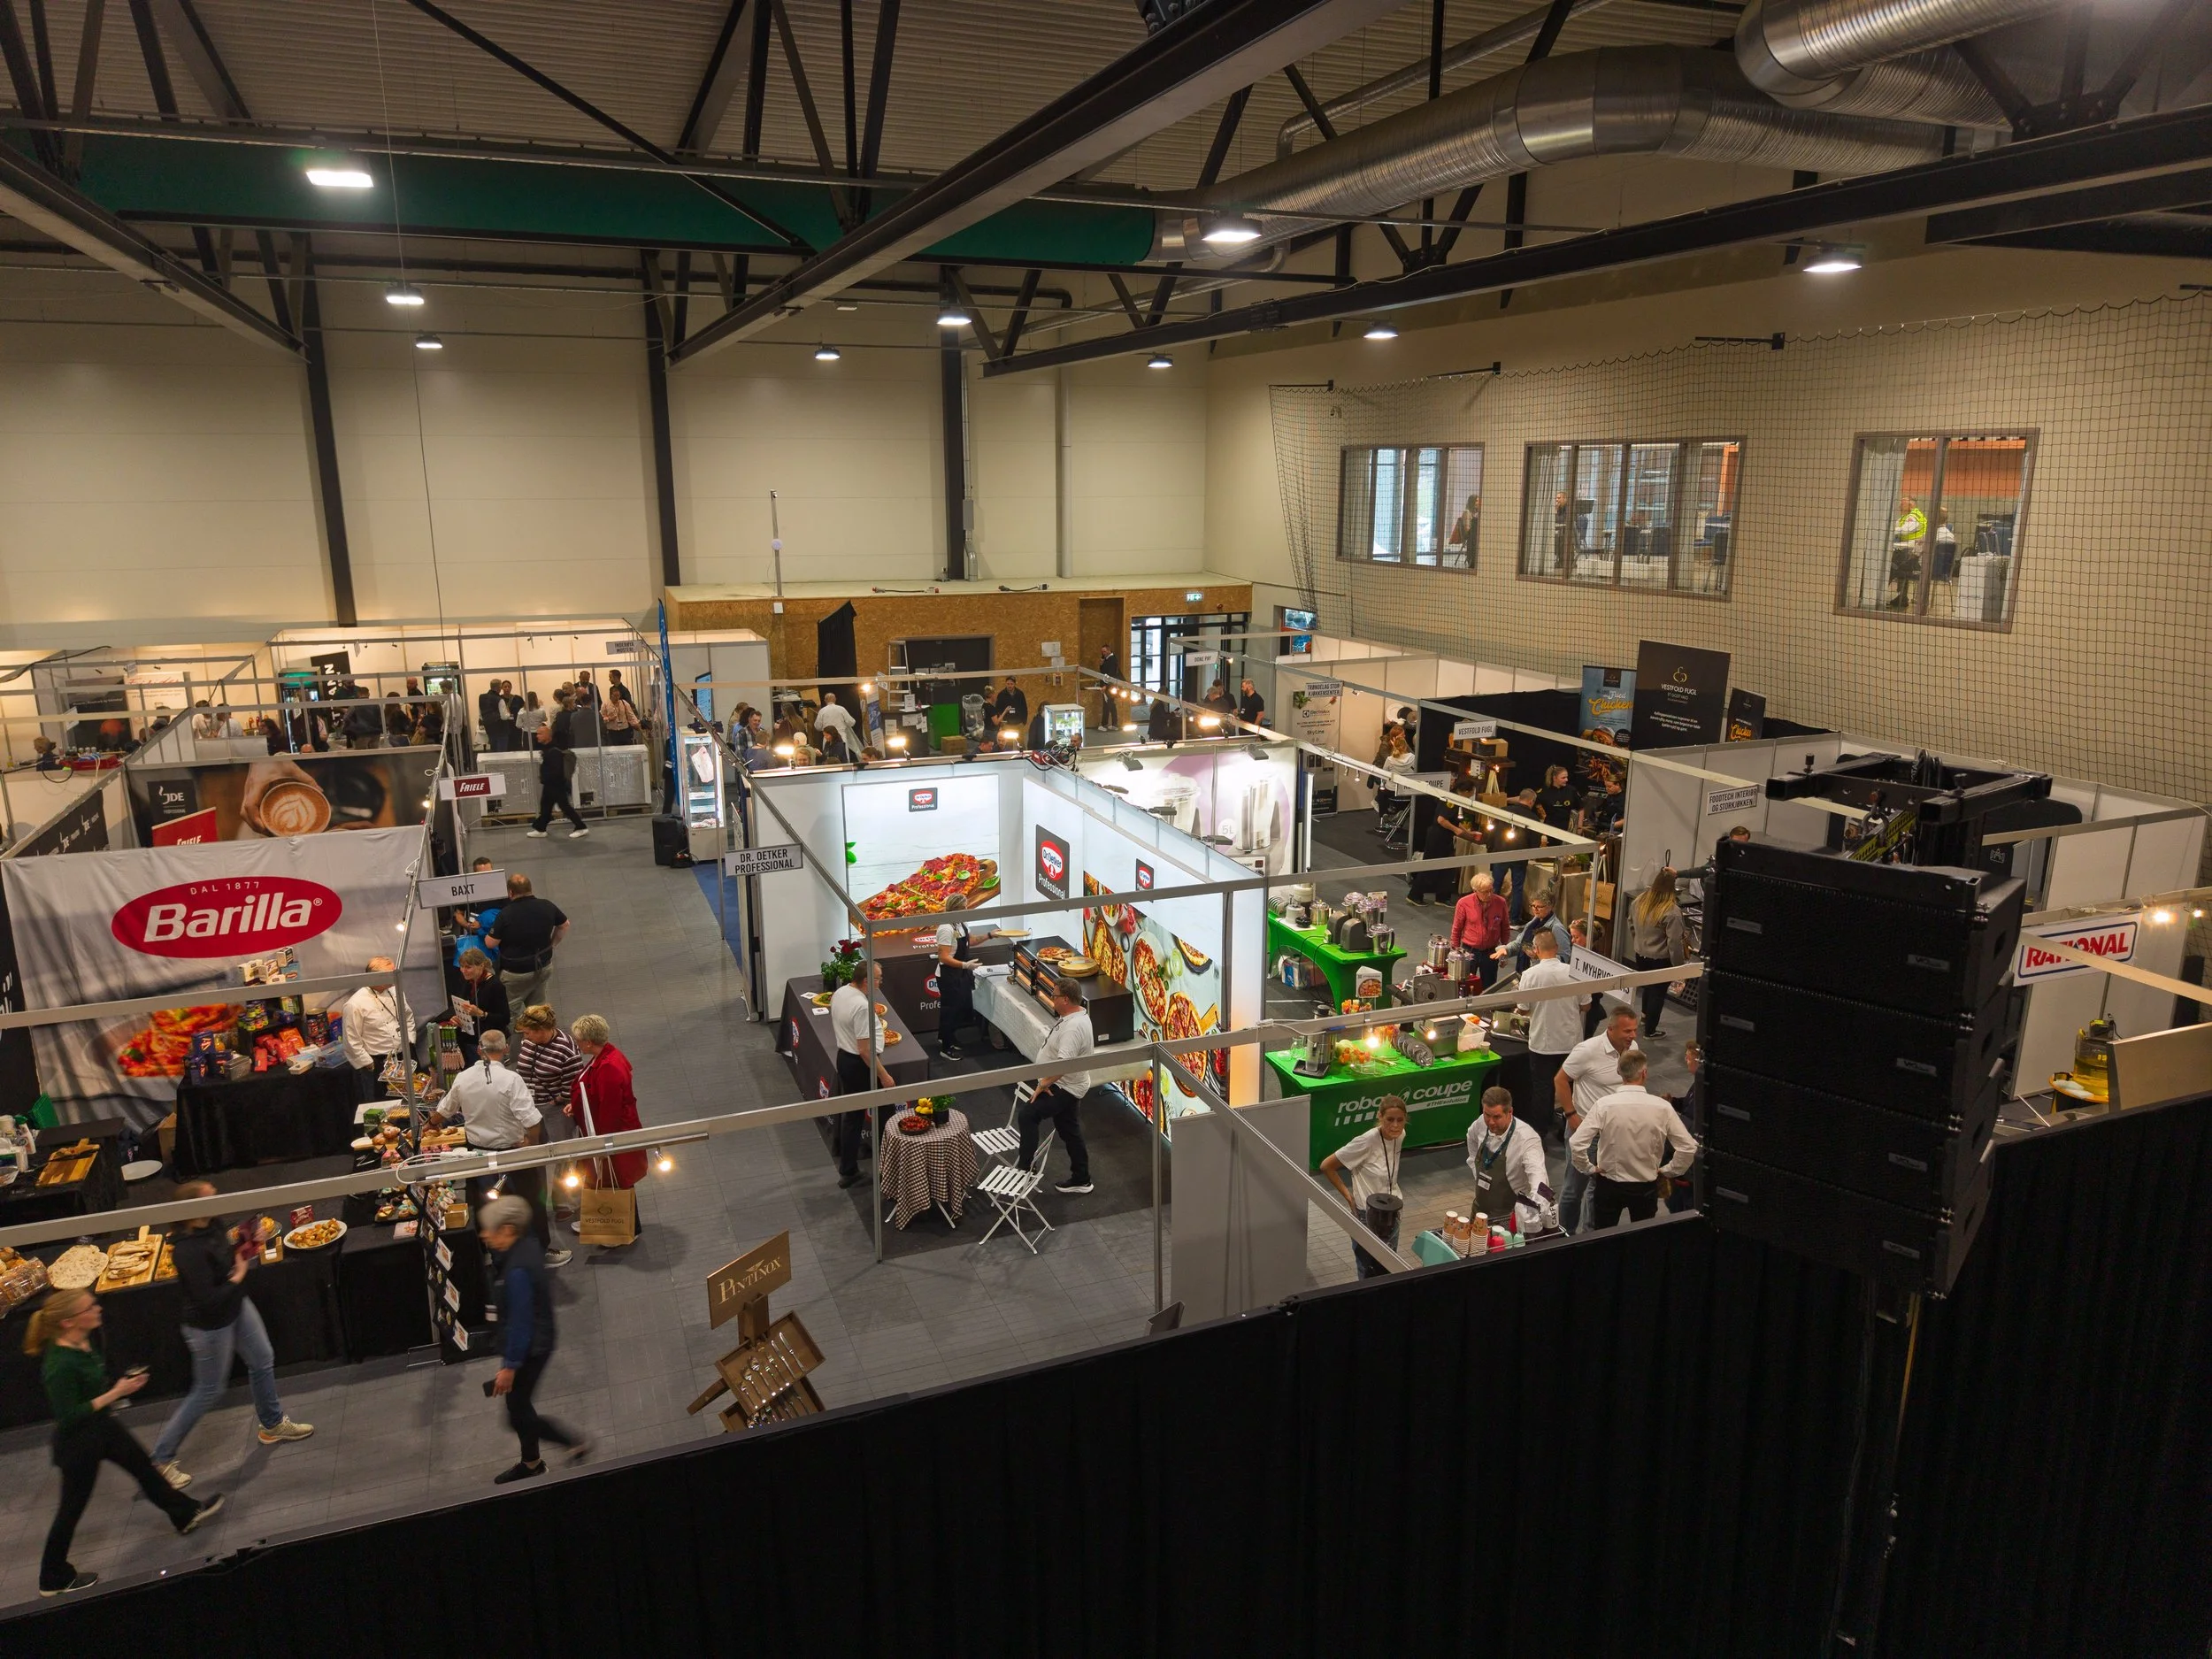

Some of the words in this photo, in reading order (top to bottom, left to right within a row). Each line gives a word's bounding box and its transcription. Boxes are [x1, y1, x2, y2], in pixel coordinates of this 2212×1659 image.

[1661, 683, 1684, 693] VESTFOLD
[1458, 726, 1481, 735] VESTFOLD
[459, 782, 485, 793] FRIELE
[163, 793, 185, 805] JDE
[1709, 792, 1734, 803] FOODTECH
[1735, 787, 1757, 799] INTERIØR
[1719, 798, 1753, 811] STORKJØKKEN
[740, 852, 754, 863] DR.
[757, 849, 788, 861] OETKER
[734, 858, 795, 874] PROFESSIONAL
[190, 885, 219, 895] DAL
[227, 881, 260, 890] 1877
[451, 883, 475, 896] BAXT
[1038, 872, 1066, 900] Professional
[143, 892, 312, 942] Barilla
[2026, 932, 2129, 968] RAONAL
[1575, 957, 1580, 971] T.
[1582, 961, 1614, 979] MYHRVO
[1338, 1093, 1392, 1113] robo
[1413, 1079, 1473, 1100] coupe
